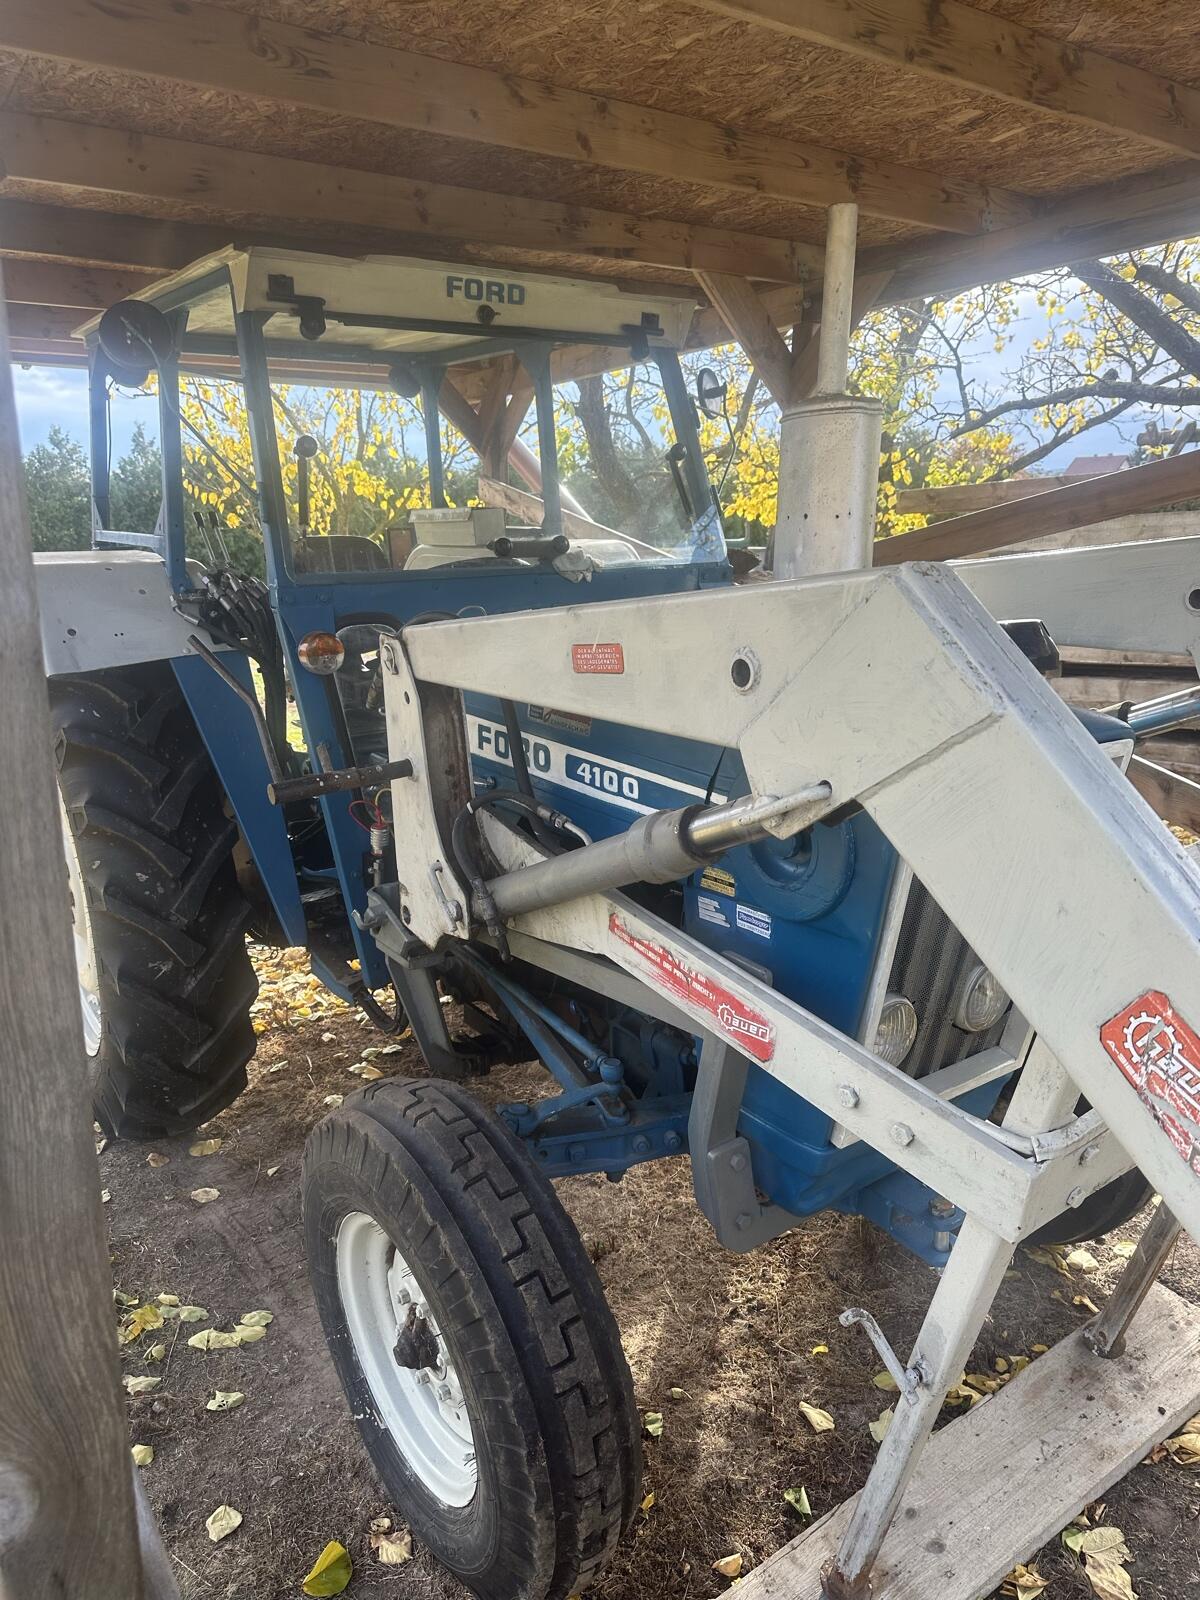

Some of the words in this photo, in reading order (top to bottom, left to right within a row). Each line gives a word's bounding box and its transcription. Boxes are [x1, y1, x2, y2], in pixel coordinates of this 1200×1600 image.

[446, 275, 526, 306] FORD
[576, 762, 639, 800] 4100
[723, 1011, 767, 1037] hauer
[1135, 1020, 1200, 1096] hau
